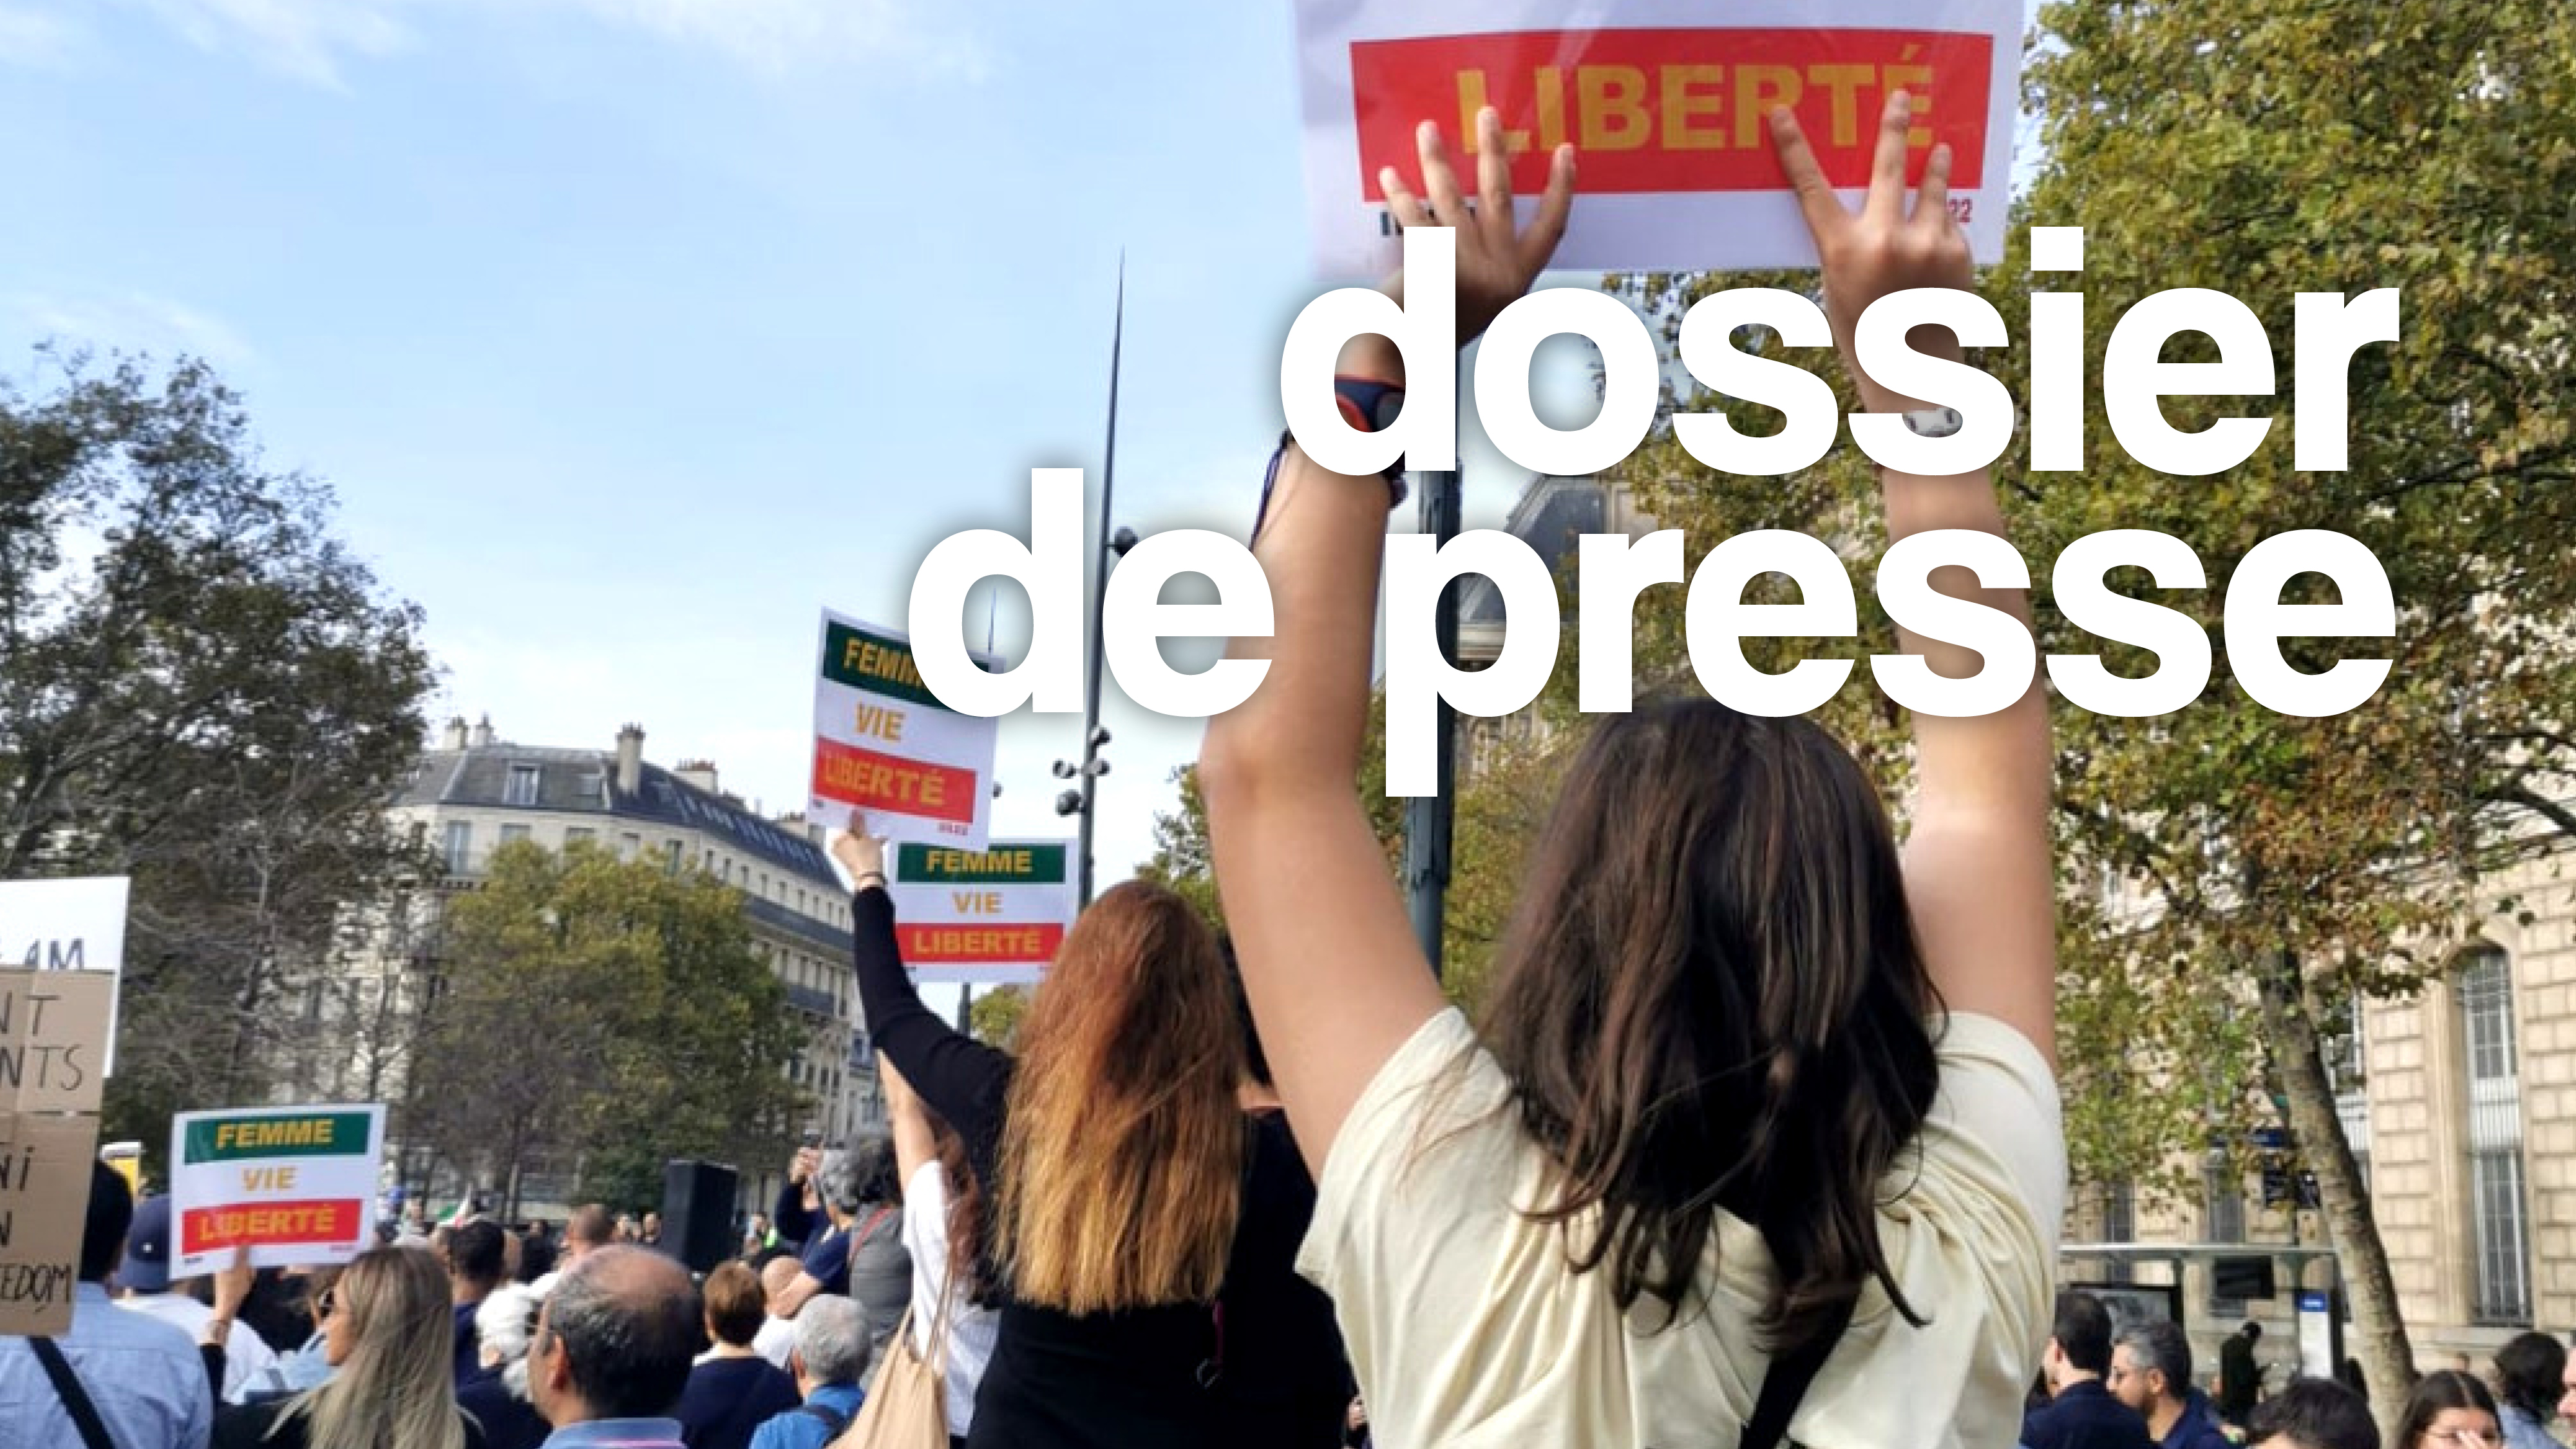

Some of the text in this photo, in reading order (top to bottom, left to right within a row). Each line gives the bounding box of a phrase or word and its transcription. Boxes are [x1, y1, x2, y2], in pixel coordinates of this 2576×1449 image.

[1455, 44, 1933, 153] LIBERTÉ
[844, 636, 926, 688] FEMM
[855, 701, 905, 741] VIE
[825, 752, 944, 805] LIBERTÉ
[926, 849, 1033, 873] FEMME
[951, 891, 1003, 914] VIE
[215, 1119, 334, 1150] FEMME
[241, 1166, 298, 1192] VIE
[198, 1204, 337, 1242] LIBERTÉ
